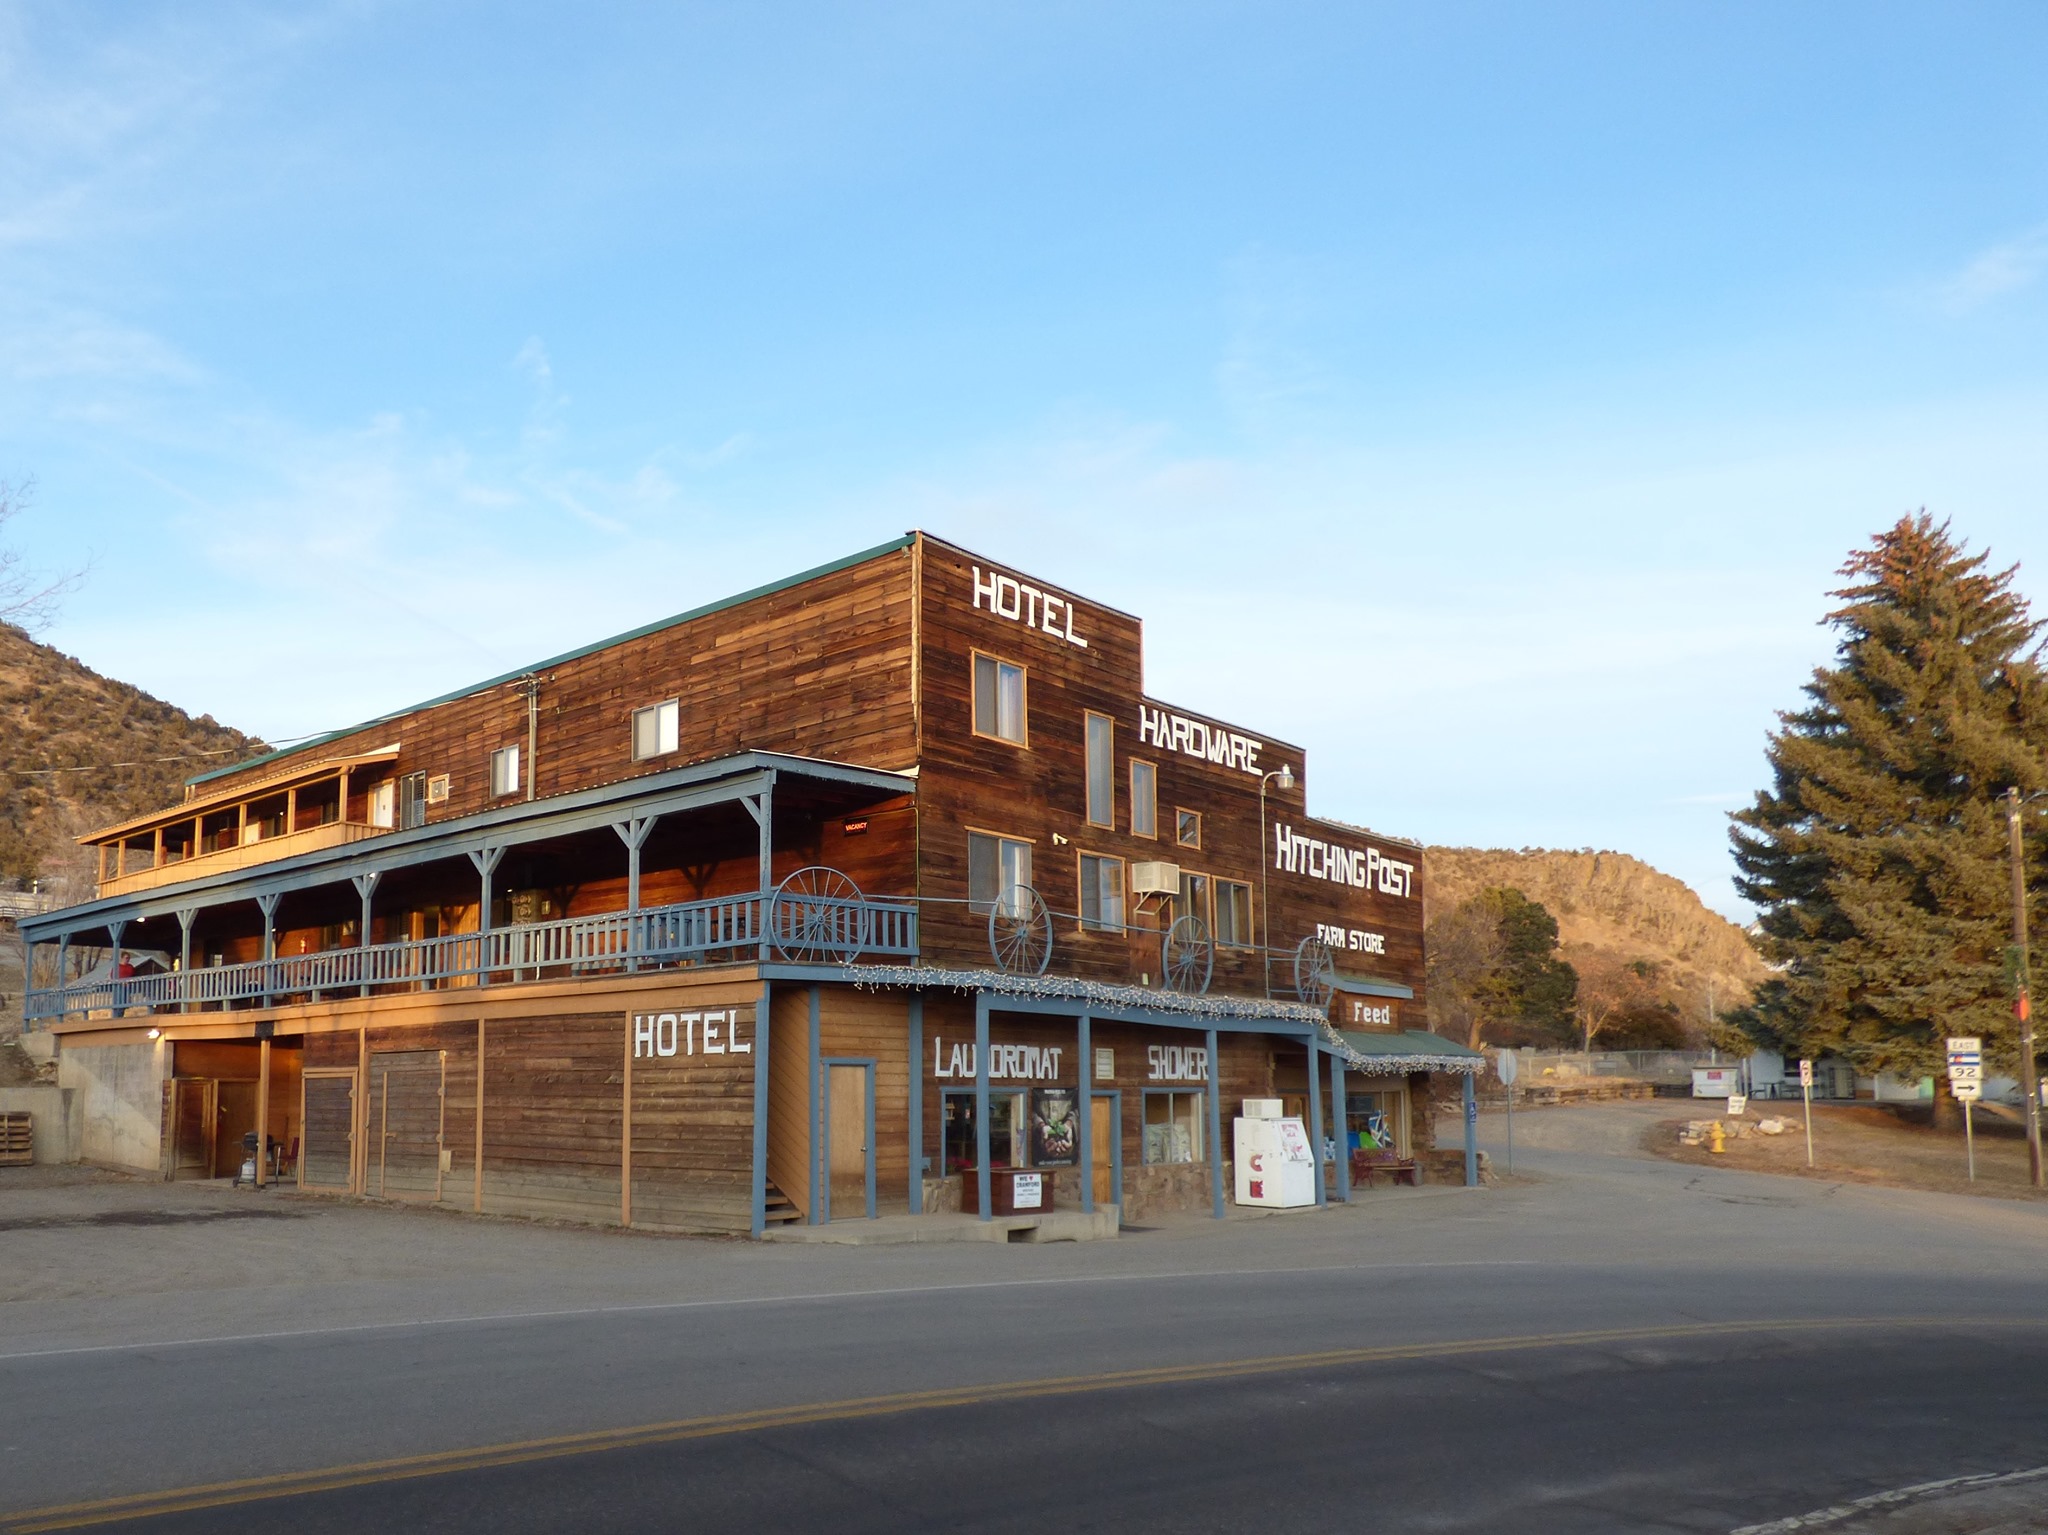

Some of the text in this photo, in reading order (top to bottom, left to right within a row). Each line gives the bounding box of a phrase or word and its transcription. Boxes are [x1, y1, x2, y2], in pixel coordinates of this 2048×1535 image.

[972, 566, 1088, 648] HOTEL
[1139, 704, 1263, 776] HARDWARE
[845, 822, 868, 831] VACANCY
[1275, 822, 1414, 898] HITCHING POST
[1317, 923, 1385, 954] FARM STORE
[1354, 1001, 1391, 1025] Feed
[634, 1010, 751, 1058] HOTEL
[1952, 1041, 1975, 1050] EAST
[934, 1036, 1063, 1080] LAUDROMAT
[1954, 1067, 1976, 1077] 92
